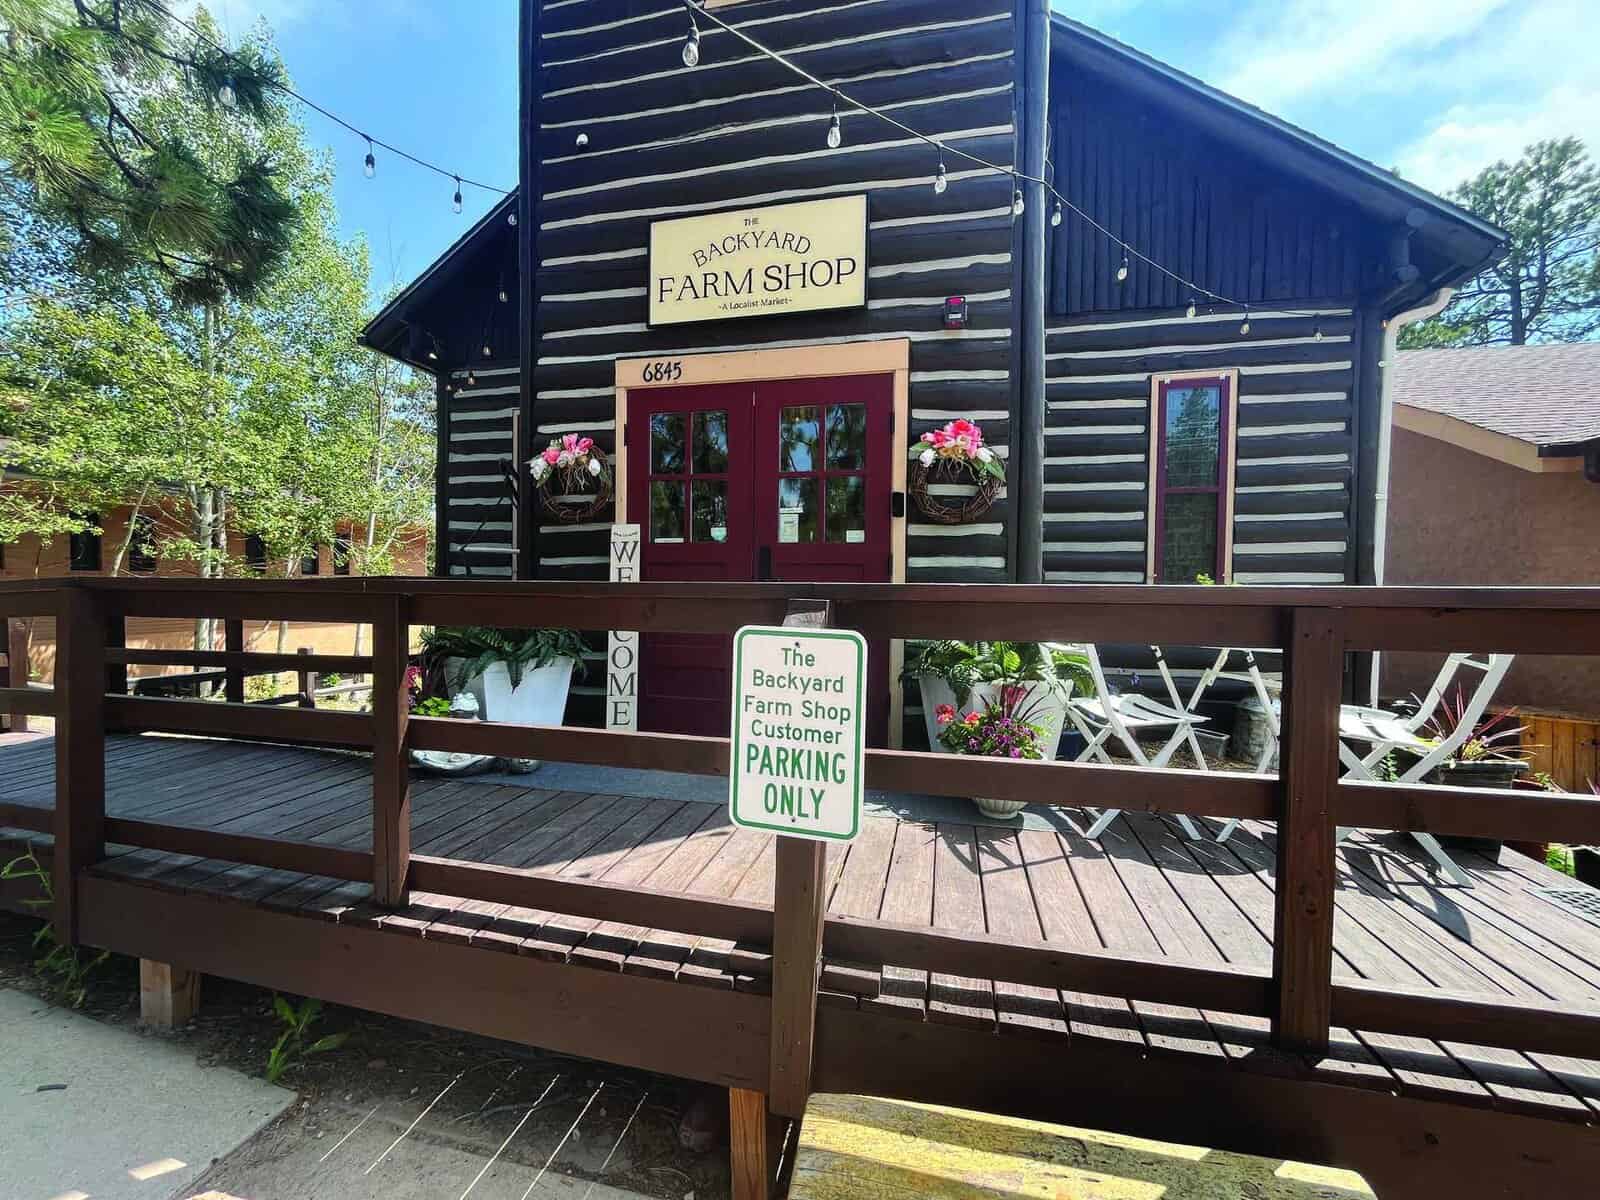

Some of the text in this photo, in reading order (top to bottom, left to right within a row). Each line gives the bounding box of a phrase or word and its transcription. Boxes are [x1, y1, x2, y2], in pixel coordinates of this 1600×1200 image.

[744, 217, 759, 227] THE
[692, 230, 812, 268] BACKYARD
[658, 257, 857, 303] FARM SHOP
[642, 361, 682, 382] 6845
[781, 647, 816, 667] The
[752, 669, 844, 695] Backyard
[744, 695, 851, 725] Farm Shop
[751, 719, 843, 745] Customer
[746, 743, 846, 785] PARKING
[764, 782, 826, 820] ONLY
